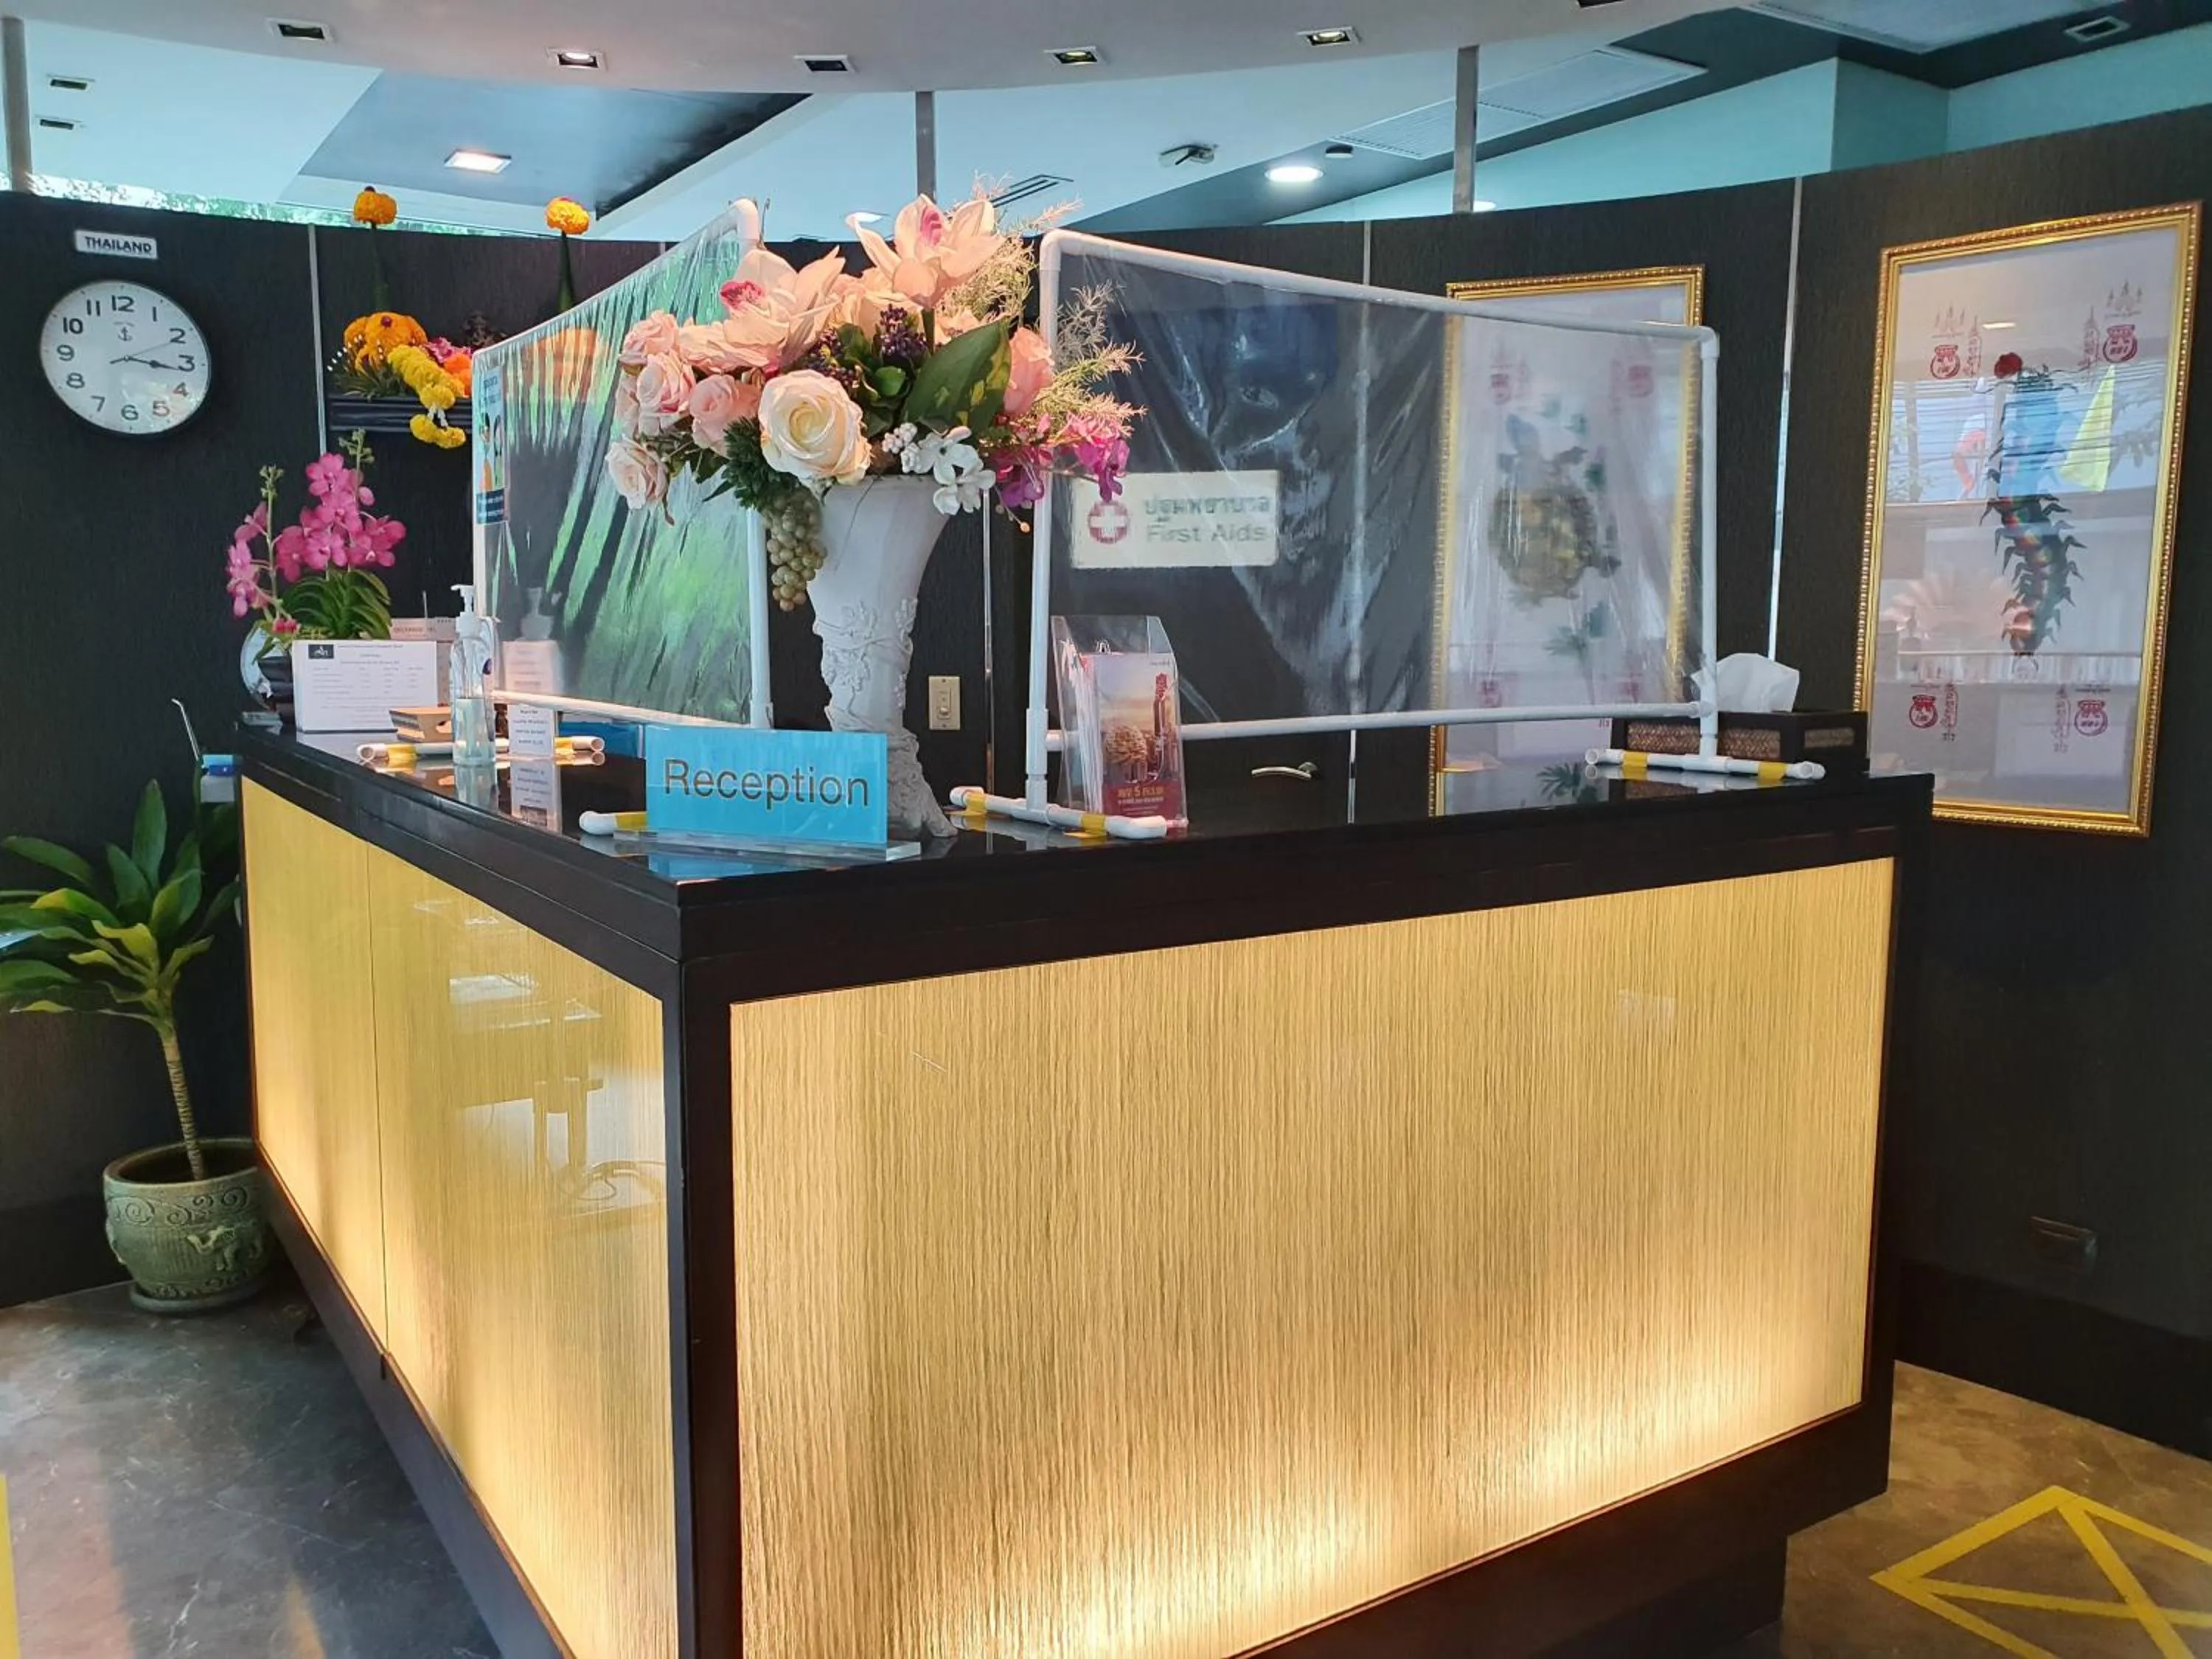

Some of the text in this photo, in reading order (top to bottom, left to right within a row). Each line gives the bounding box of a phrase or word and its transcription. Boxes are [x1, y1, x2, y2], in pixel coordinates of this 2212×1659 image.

[85, 236, 152, 254] THAILAND
[86, 299, 101, 316] 11
[111, 295, 135, 313] 12
[153, 306, 157, 321] 1
[63, 318, 83, 335] 10
[169, 328, 186, 344] 2
[57, 344, 74, 361] 9
[178, 355, 195, 372] 3
[66, 372, 85, 389] 8
[173, 382, 189, 396] 4
[91, 396, 105, 412] 7
[121, 405, 139, 420] 6
[153, 401, 170, 417] 5
[1147, 523, 1266, 543] First Aids
[664, 759, 869, 810] Reception
